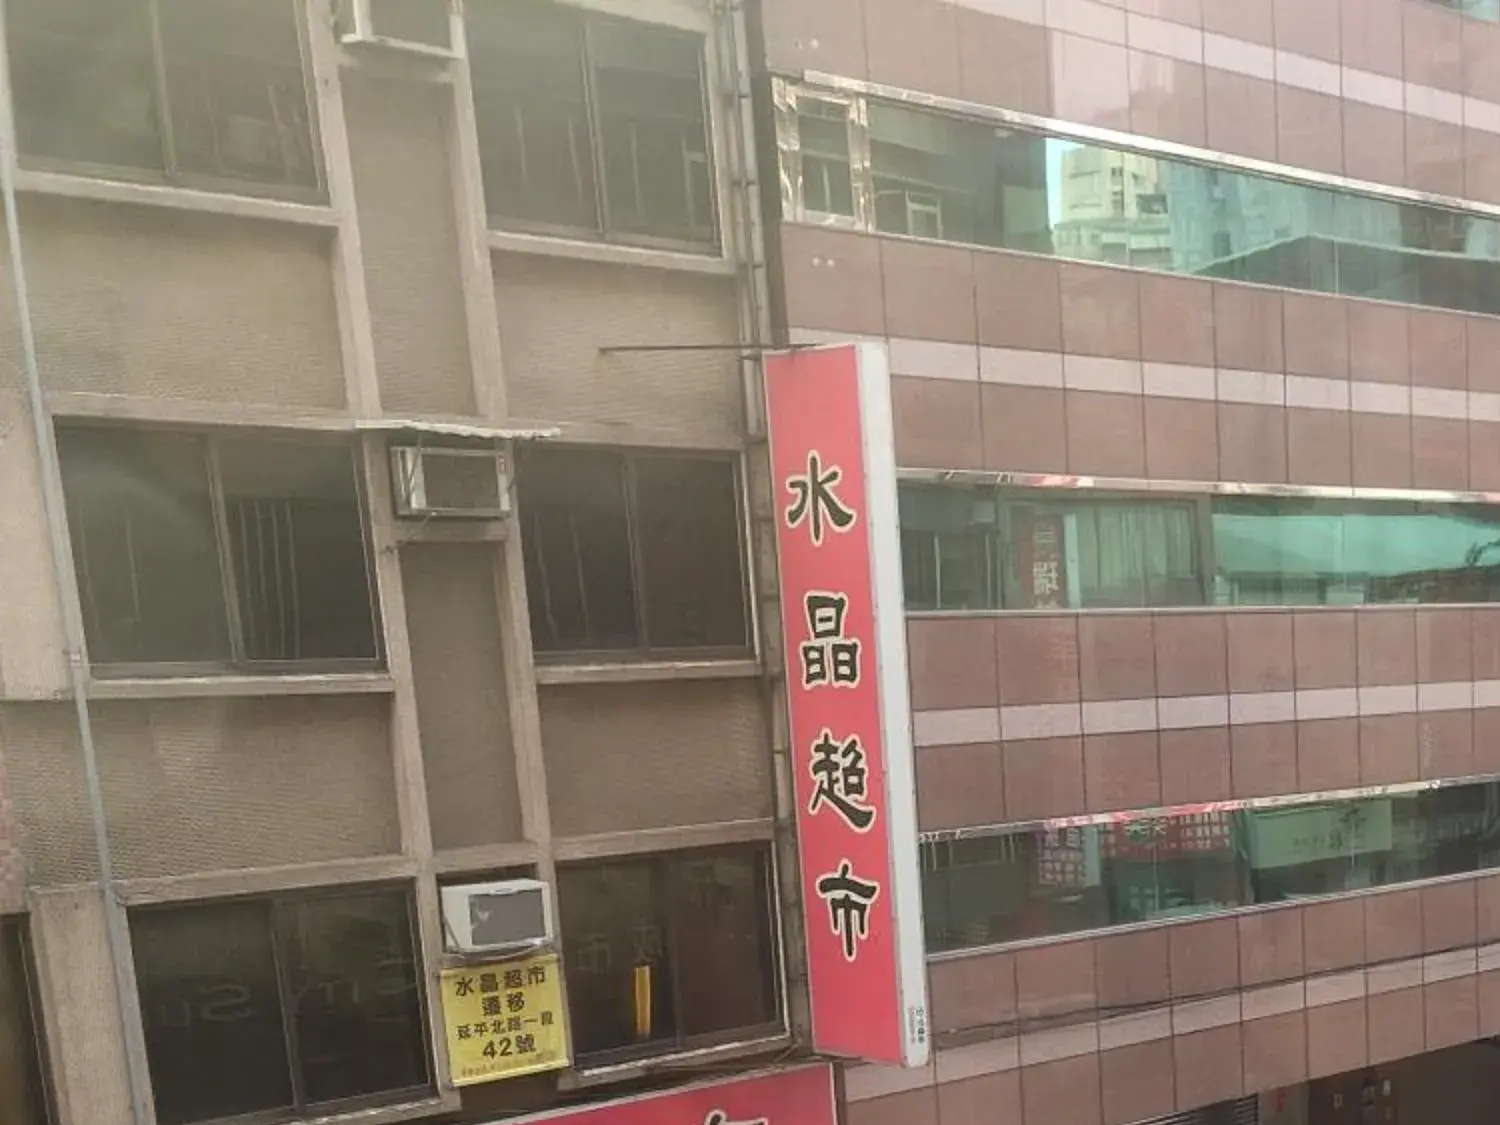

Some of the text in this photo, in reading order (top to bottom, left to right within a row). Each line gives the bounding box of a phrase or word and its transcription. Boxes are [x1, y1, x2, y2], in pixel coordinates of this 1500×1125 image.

[785, 450, 879, 961] 水晶超市
[455, 966, 546, 997] 水晶超市
[482, 1033, 537, 1061] 42號
